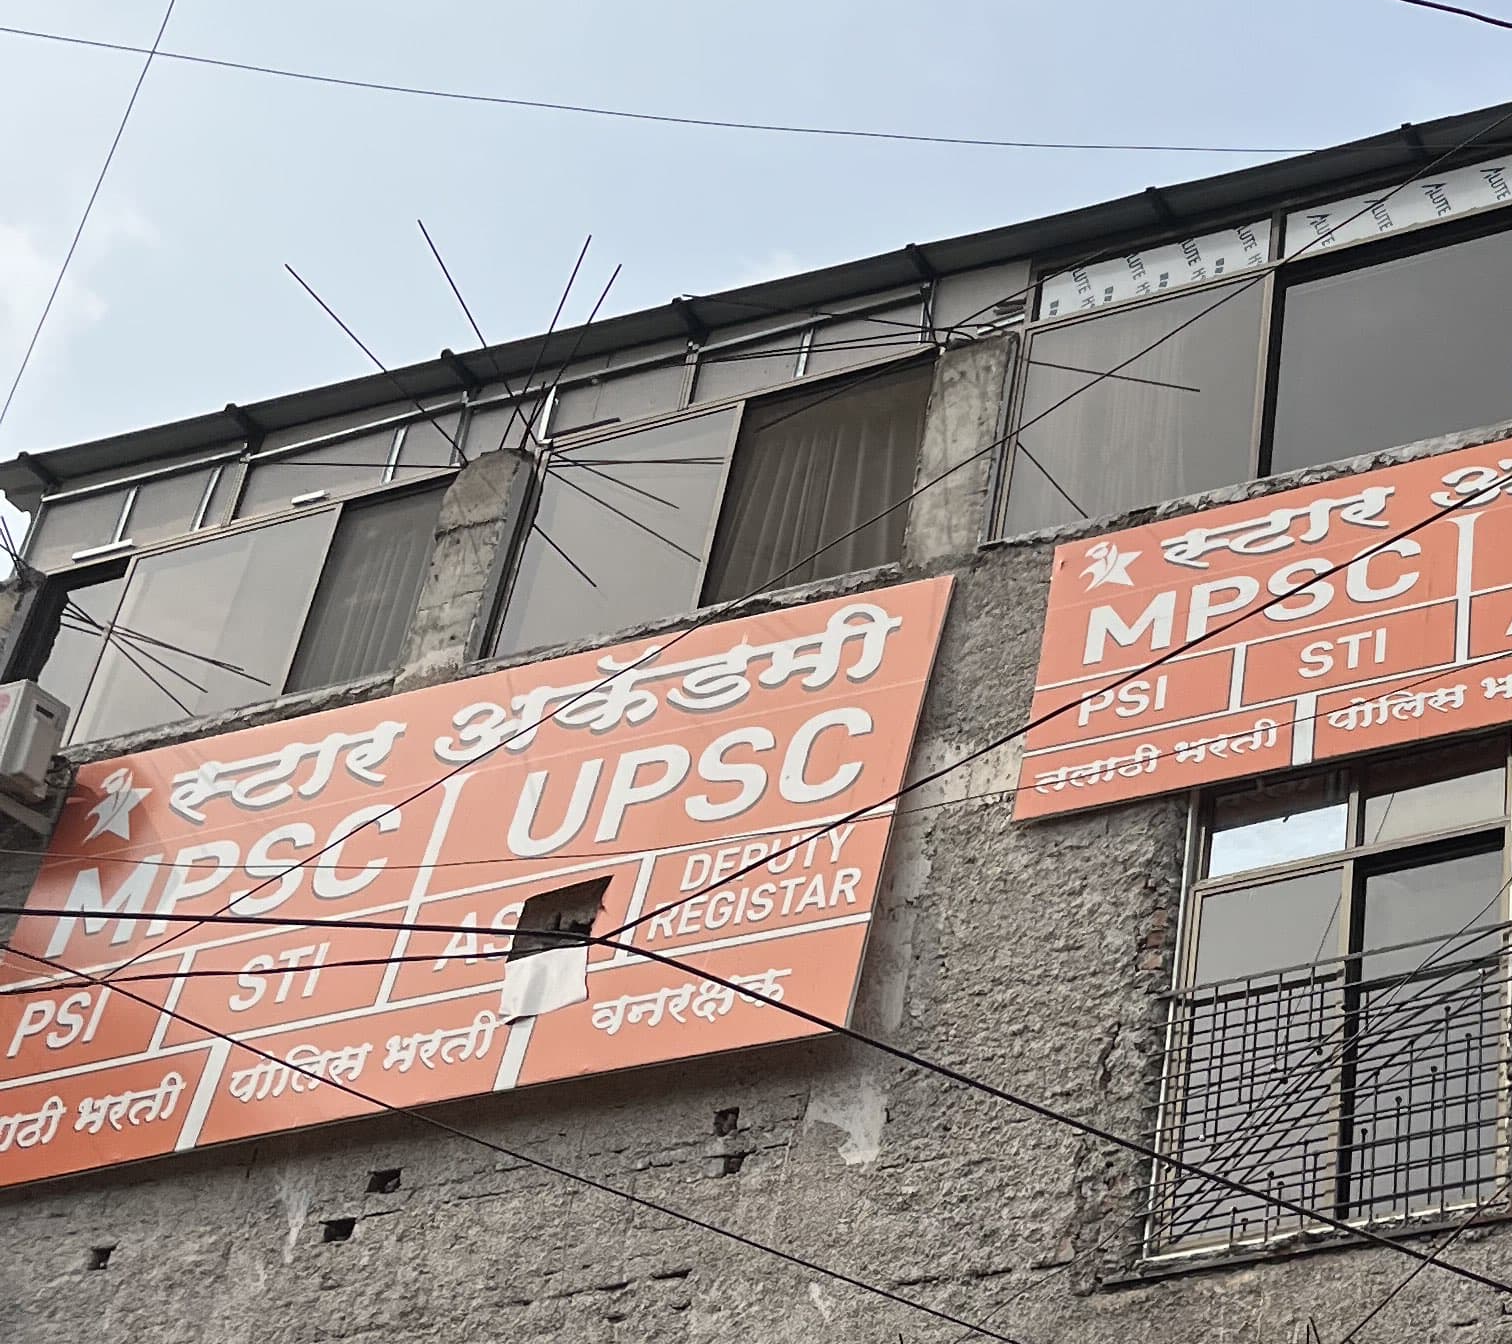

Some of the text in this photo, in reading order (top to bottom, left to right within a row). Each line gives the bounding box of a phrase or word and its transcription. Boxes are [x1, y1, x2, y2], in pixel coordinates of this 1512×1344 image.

[1160, 486, 1396, 568] स्टार
[1082, 537, 1423, 666] MPSC
[1298, 627, 1388, 679] STI
[170, 603, 902, 824] स्टार अकॅडमी
[1077, 675, 1168, 727] PSI
[1327, 684, 1467, 733] पोलिस
[1175, 718, 1280, 764] भरती
[507, 707, 874, 857] UPSC
[44, 804, 403, 959] MPSC
[680, 824, 857, 892] DEPUTY
[433, 902, 526, 971] AS
[646, 867, 863, 942] REGISTAR
[229, 941, 331, 1012] STI
[6, 986, 113, 1057] PSI
[381, 1009, 504, 1073] भरती
[73, 1071, 188, 1136] भरती
